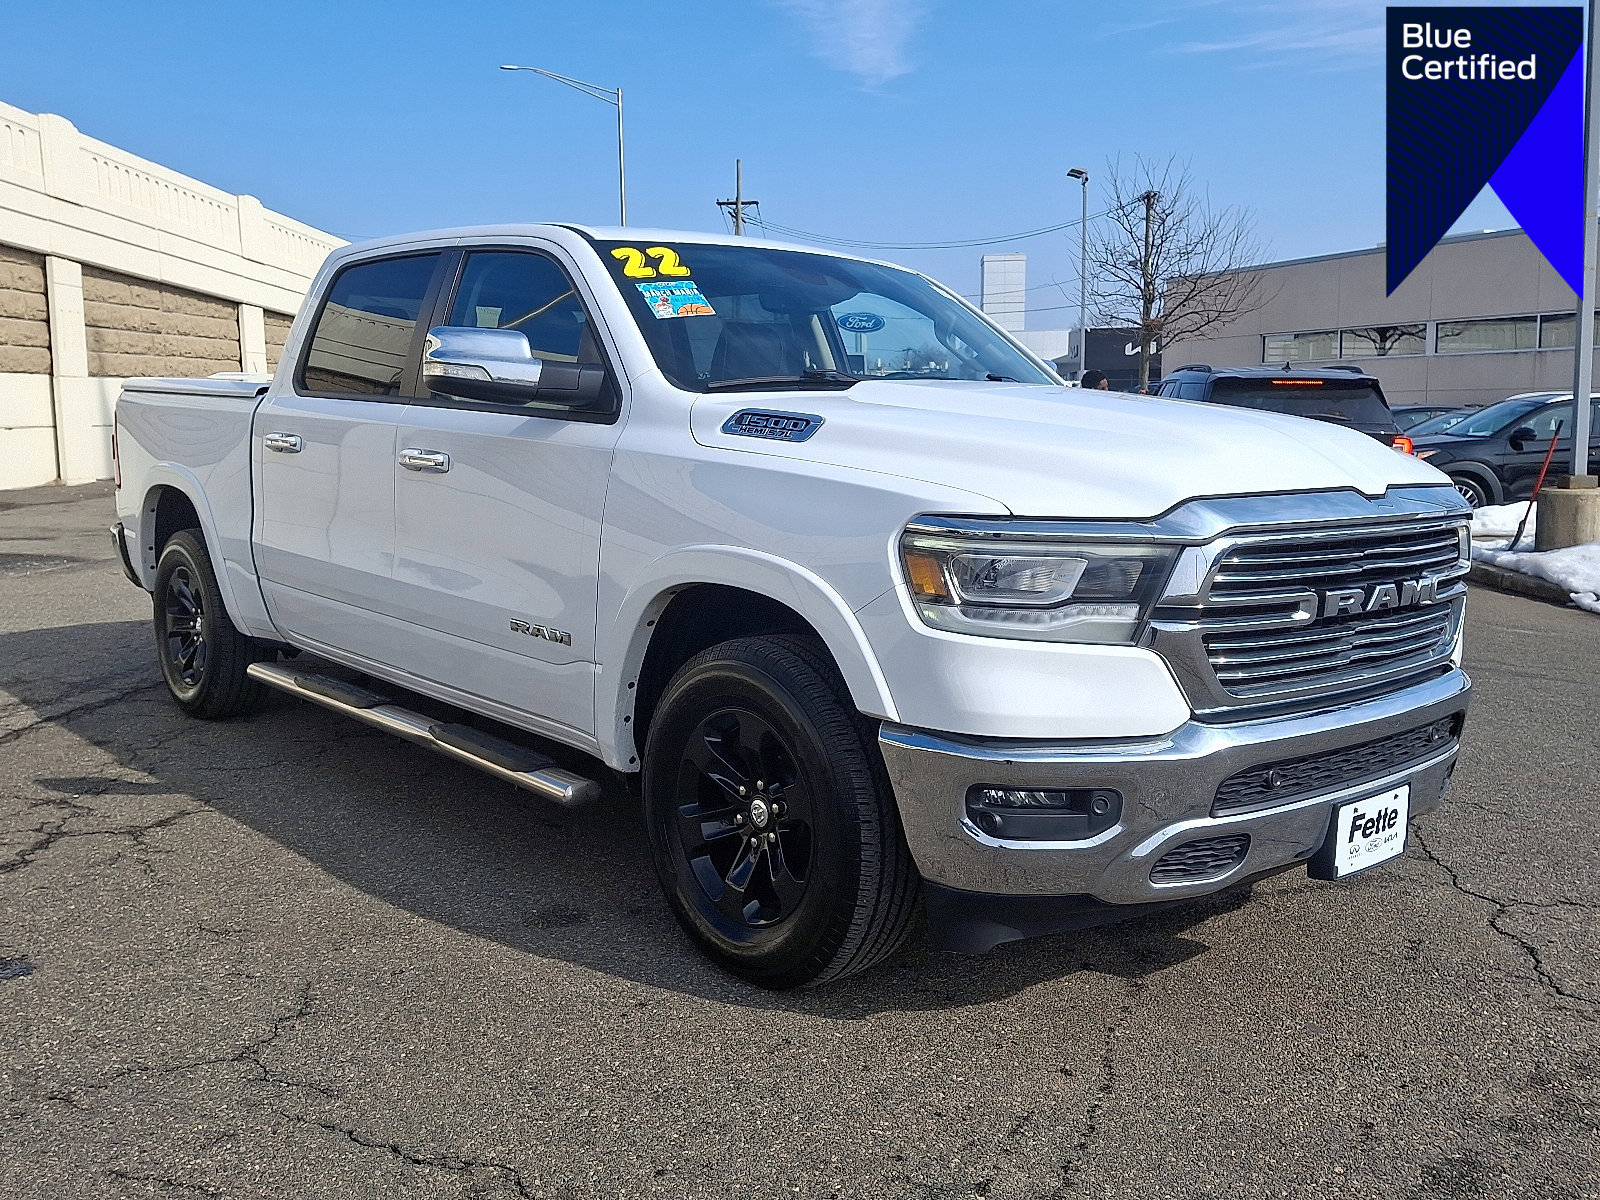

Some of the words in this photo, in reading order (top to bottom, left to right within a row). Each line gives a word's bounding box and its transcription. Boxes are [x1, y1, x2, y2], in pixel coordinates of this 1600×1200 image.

[610, 246, 691, 278] 22
[642, 288, 672, 298] MARCH
[846, 316, 876, 329] Ford
[739, 425, 767, 436] HEMI
[740, 414, 806, 431] 1500
[1324, 577, 1432, 618] RAM
[509, 617, 572, 646] RAM
[1348, 807, 1398, 843] Fette
